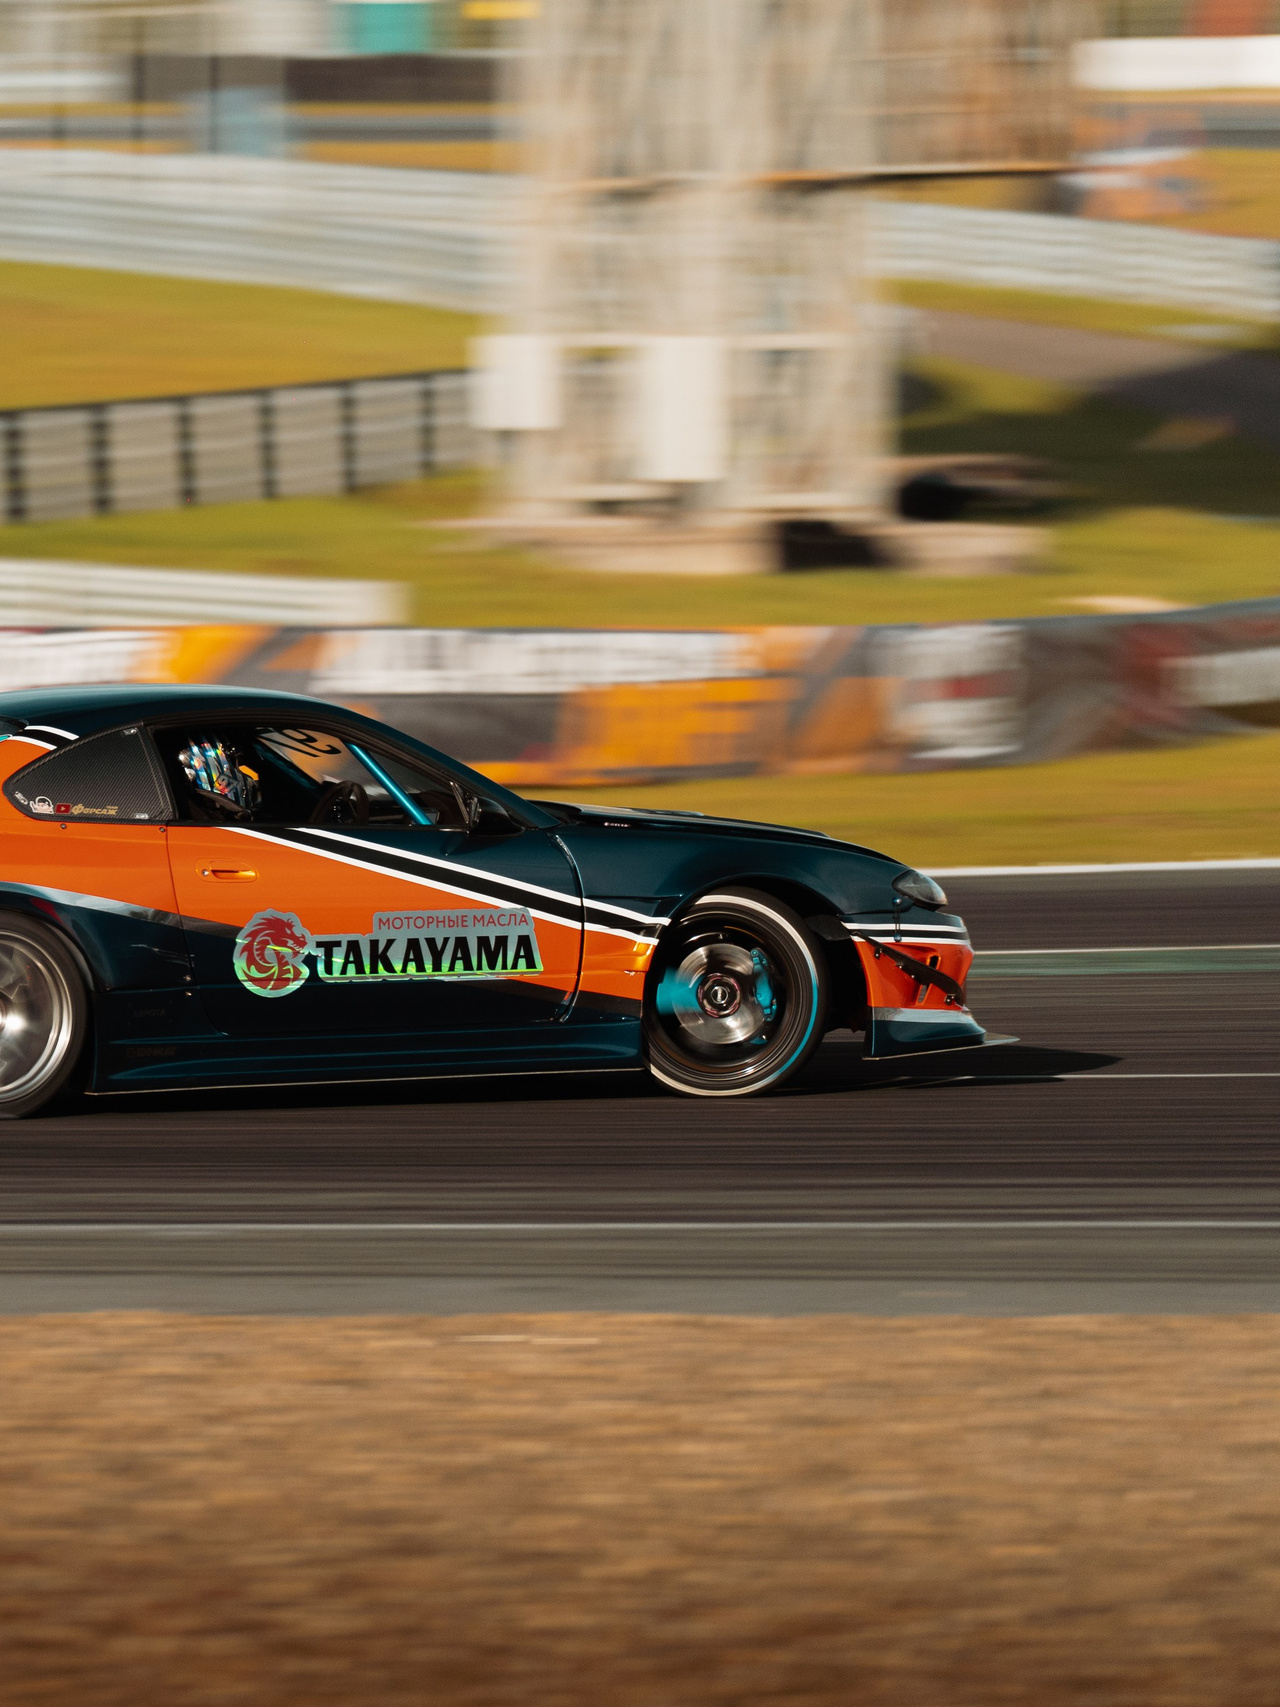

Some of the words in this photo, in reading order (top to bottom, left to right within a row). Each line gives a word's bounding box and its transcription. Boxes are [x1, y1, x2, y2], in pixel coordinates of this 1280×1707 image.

[378, 915, 468, 930] МОТОРНЫЕ
[472, 913, 529, 927] МАСЛА
[314, 934, 538, 976] TAKAYAMA
